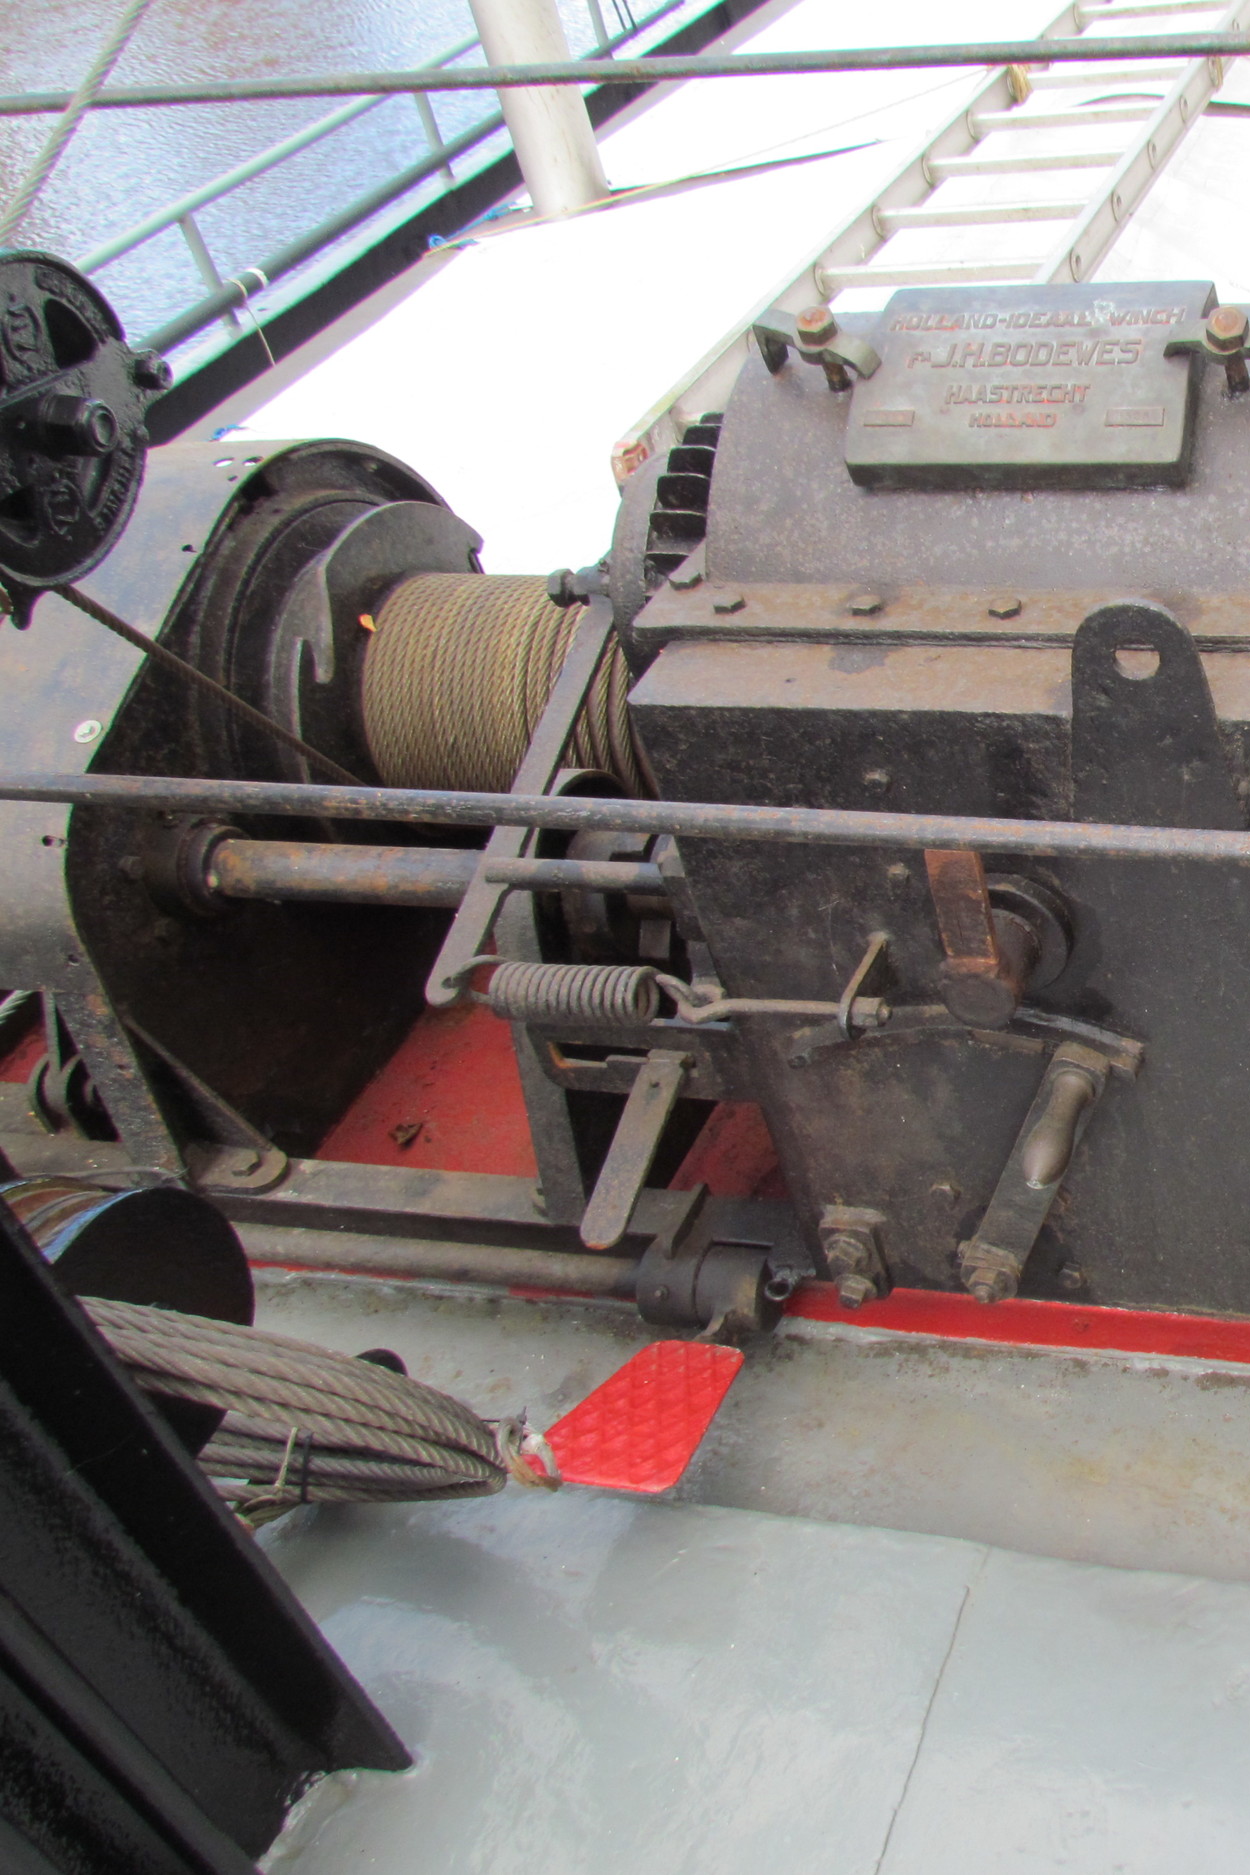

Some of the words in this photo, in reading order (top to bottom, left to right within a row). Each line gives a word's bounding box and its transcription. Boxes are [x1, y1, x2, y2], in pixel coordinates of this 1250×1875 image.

[1108, 307, 1185, 327] WINCH
[944, 383, 1091, 404] HAASTRECHT
[968, 412, 1057, 428] HOLLAND
